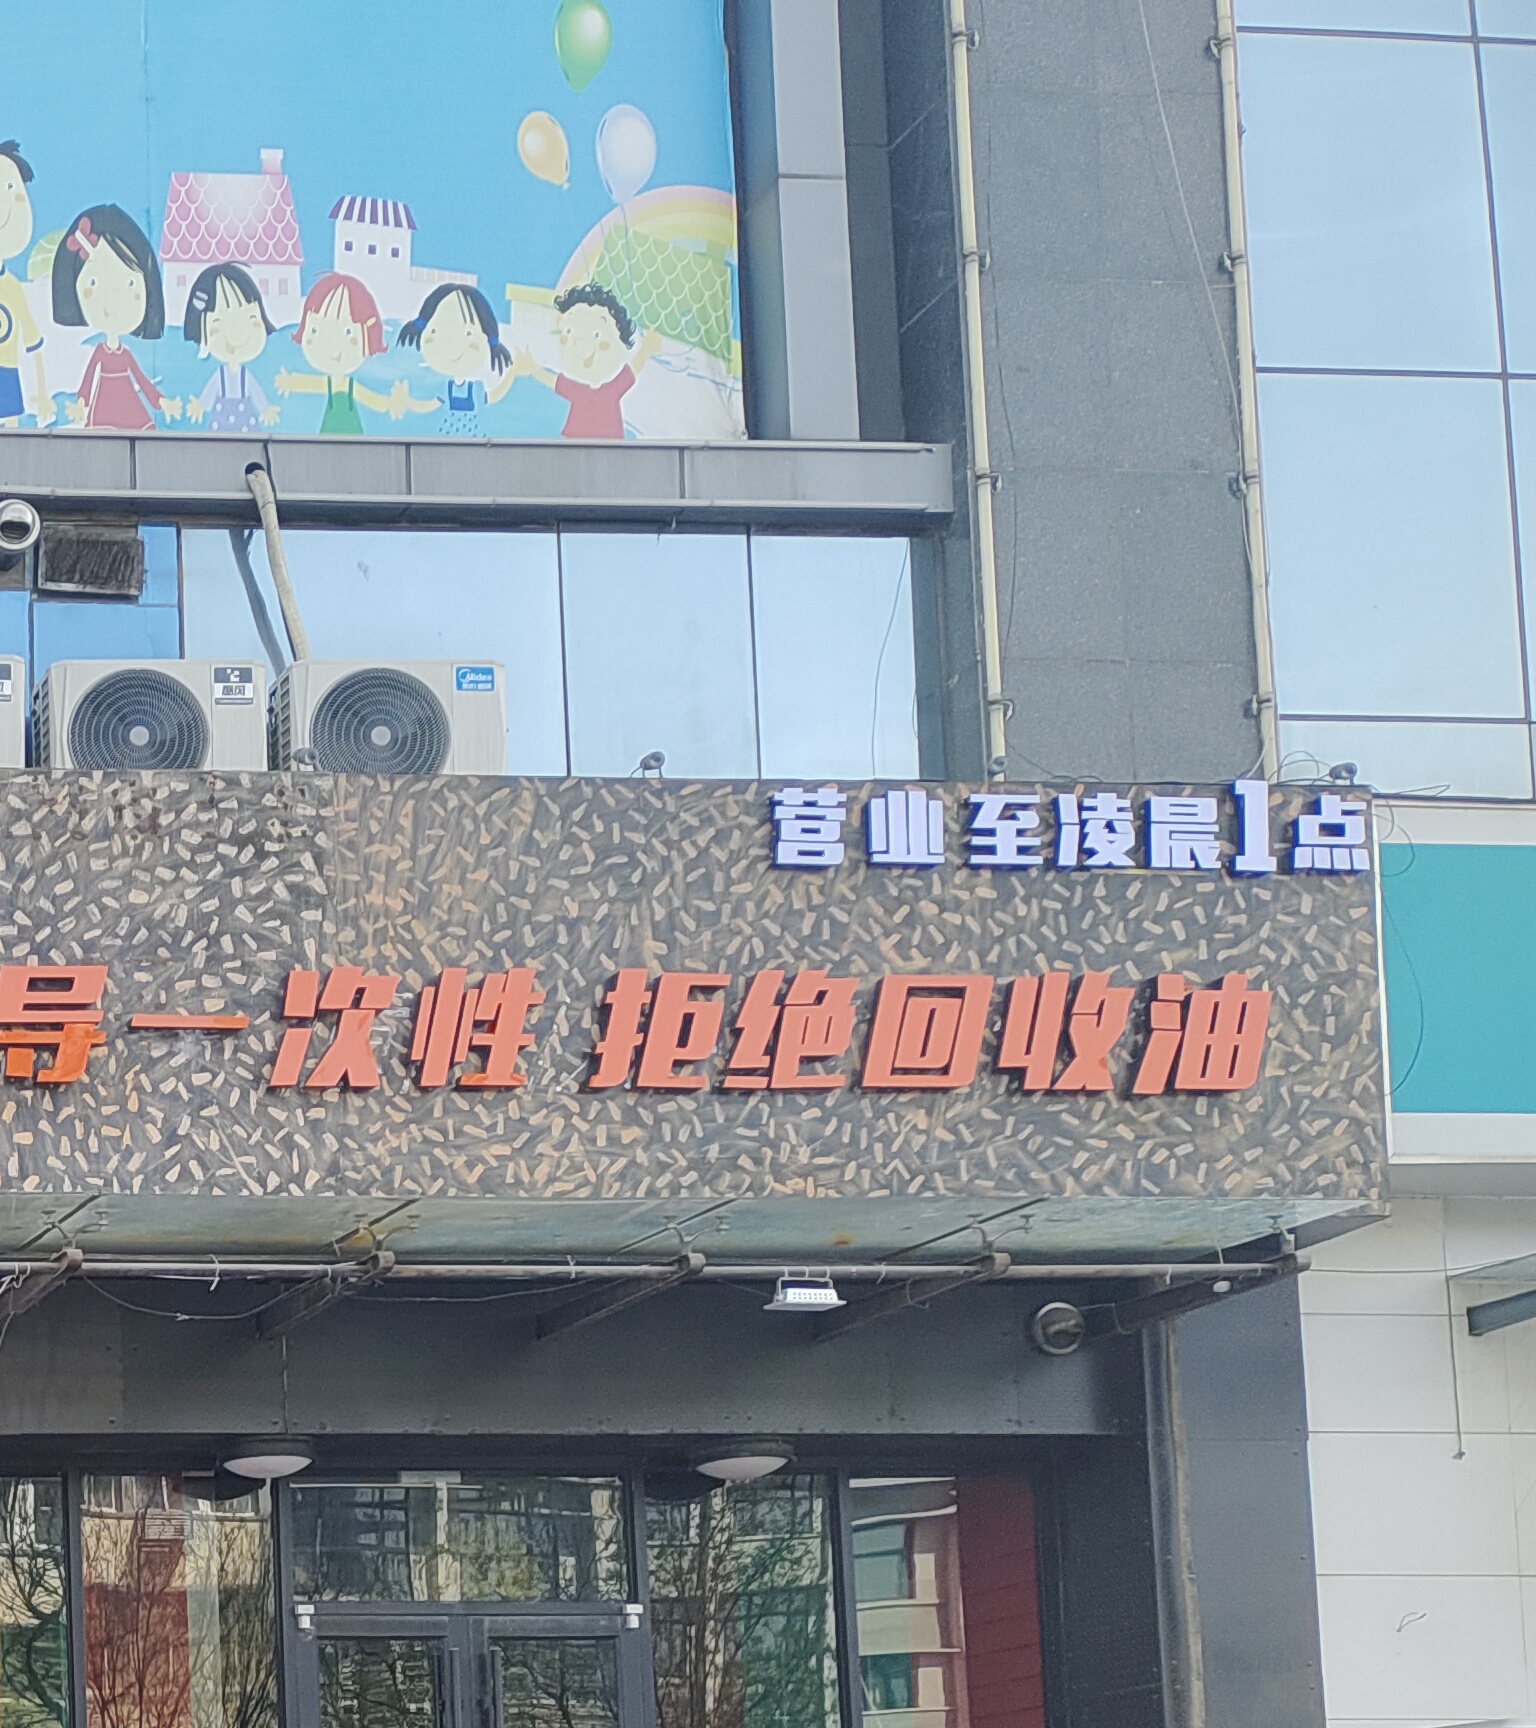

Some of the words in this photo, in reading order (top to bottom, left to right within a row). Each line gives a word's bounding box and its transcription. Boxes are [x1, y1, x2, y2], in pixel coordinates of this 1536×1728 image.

[773, 779, 1371, 873] 营业至凌晨1点
[589, 968, 1273, 1095] 拒绝回收油
